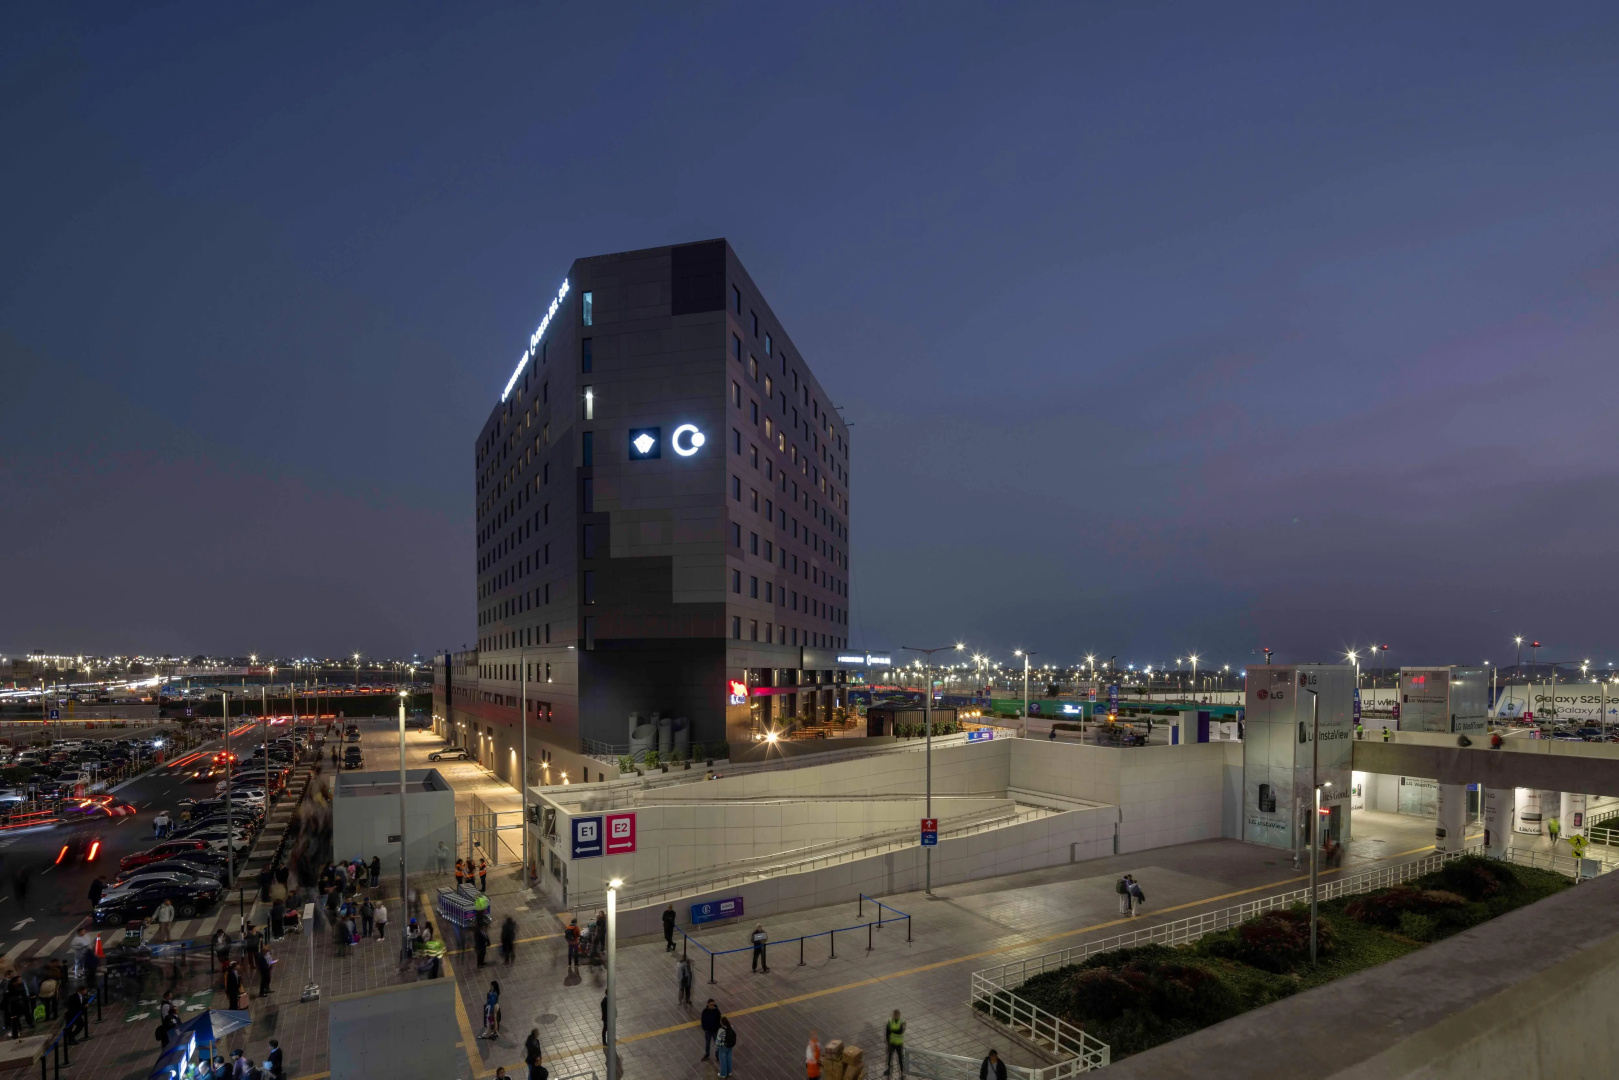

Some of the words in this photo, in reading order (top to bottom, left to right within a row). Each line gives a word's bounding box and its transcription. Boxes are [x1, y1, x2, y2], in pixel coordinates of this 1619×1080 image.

[1308, 675, 1317, 685] LG
[1270, 691, 1284, 700] LG
[1535, 695, 1578, 705] Gaaxy
[1580, 695, 1601, 704] S25
[1556, 706, 1594, 716] Galaxy
[581, 826, 594, 836] E1
[614, 822, 628, 833] E2
